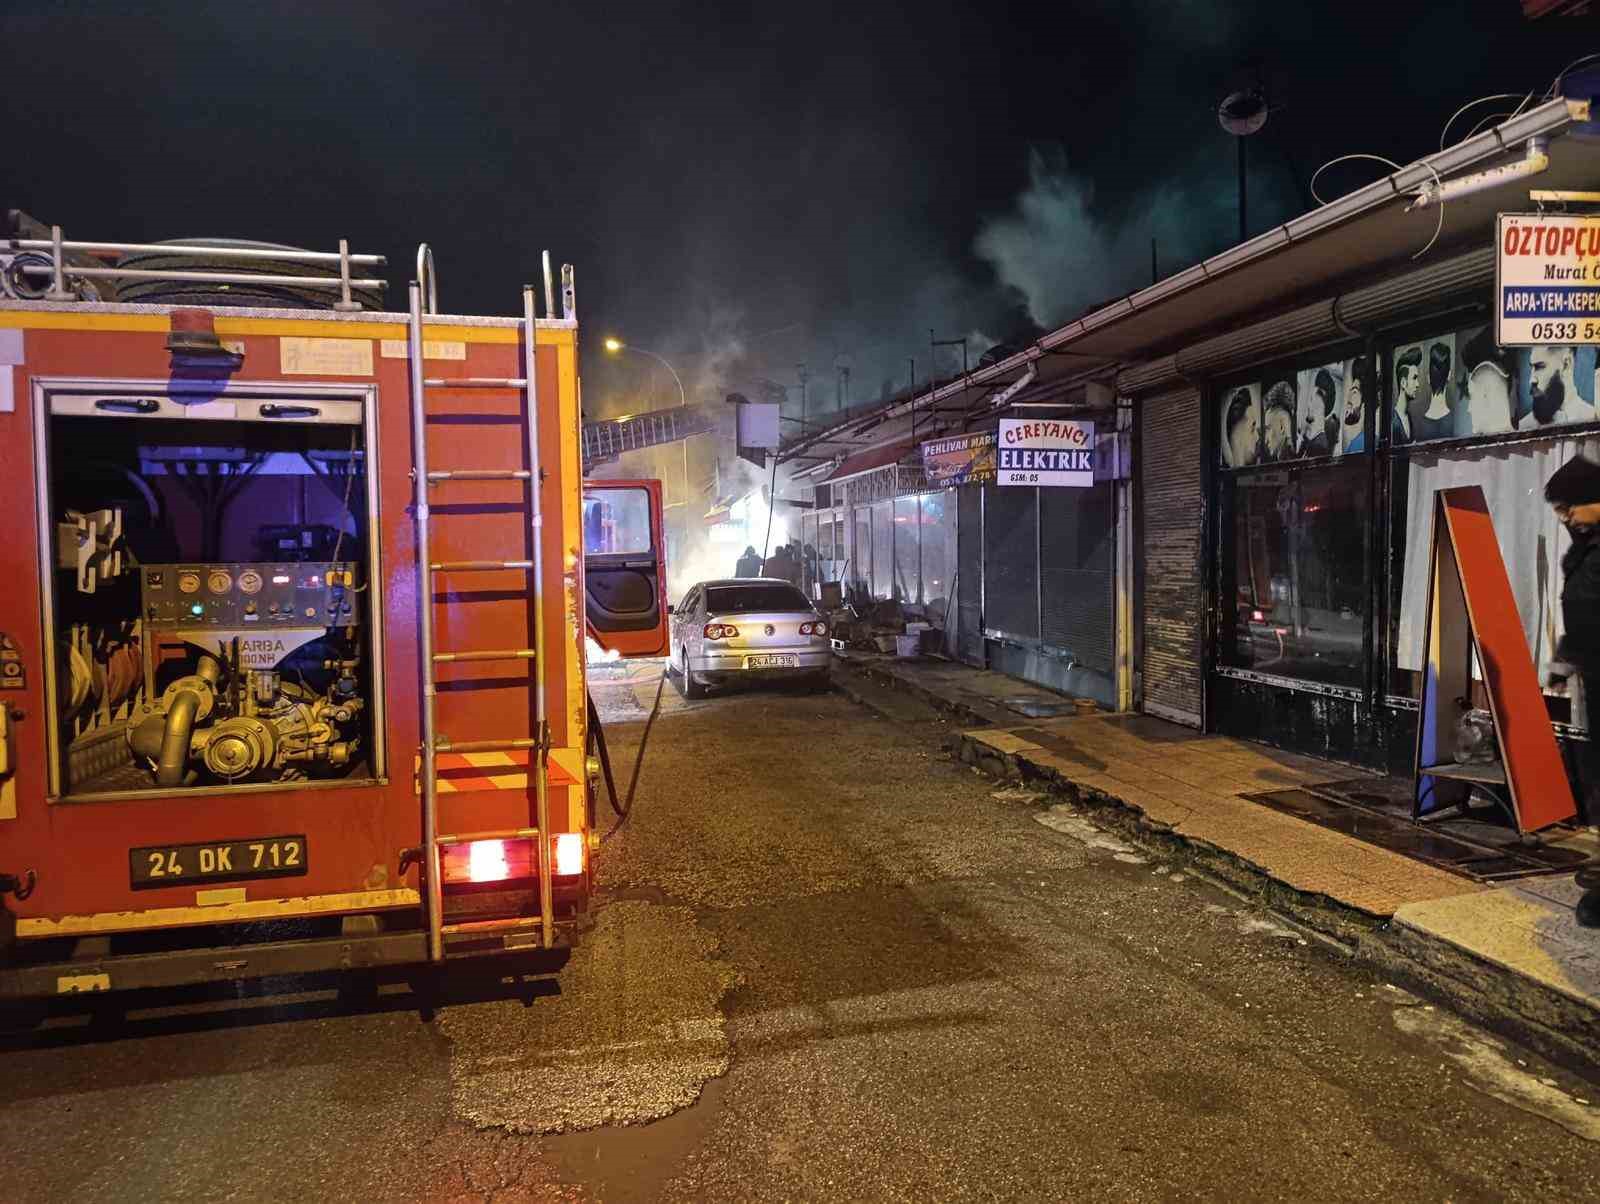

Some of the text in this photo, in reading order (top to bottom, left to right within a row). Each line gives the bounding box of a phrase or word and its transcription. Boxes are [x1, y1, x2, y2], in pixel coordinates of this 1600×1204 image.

[1544, 264, 1588, 280] Murat
[1531, 322, 1577, 340] 0533
[1000, 448, 1092, 470] ELEKTRİK
[149, 841, 300, 877] 24 DK 712
